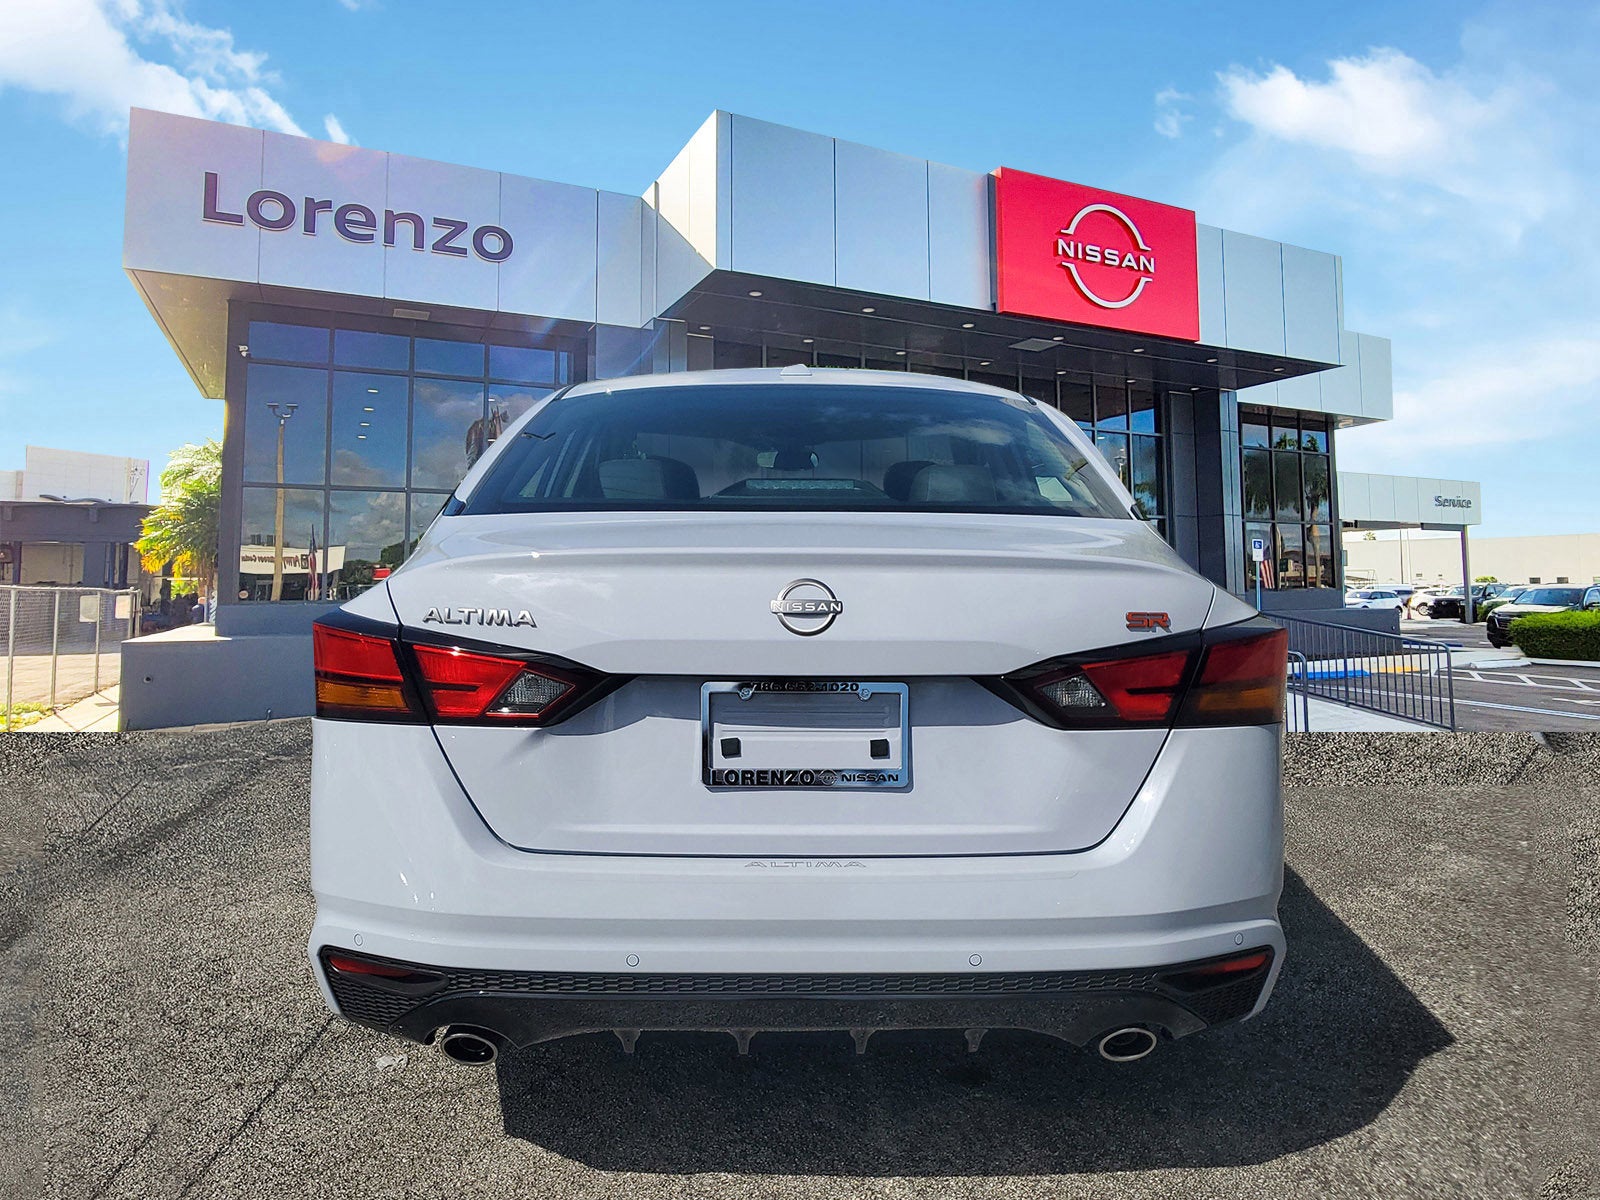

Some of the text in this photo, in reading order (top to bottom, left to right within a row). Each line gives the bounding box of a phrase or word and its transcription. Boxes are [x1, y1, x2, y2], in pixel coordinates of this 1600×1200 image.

[202, 171, 515, 263] Lorenzo
[1057, 238, 1155, 273] NISSAN
[1434, 495, 1472, 509] Service
[772, 602, 841, 612] NISSAN
[422, 607, 537, 628] ALTIMA
[1125, 611, 1171, 630] SR
[710, 768, 815, 786] LORENZO
[841, 773, 899, 783] NISSAN
